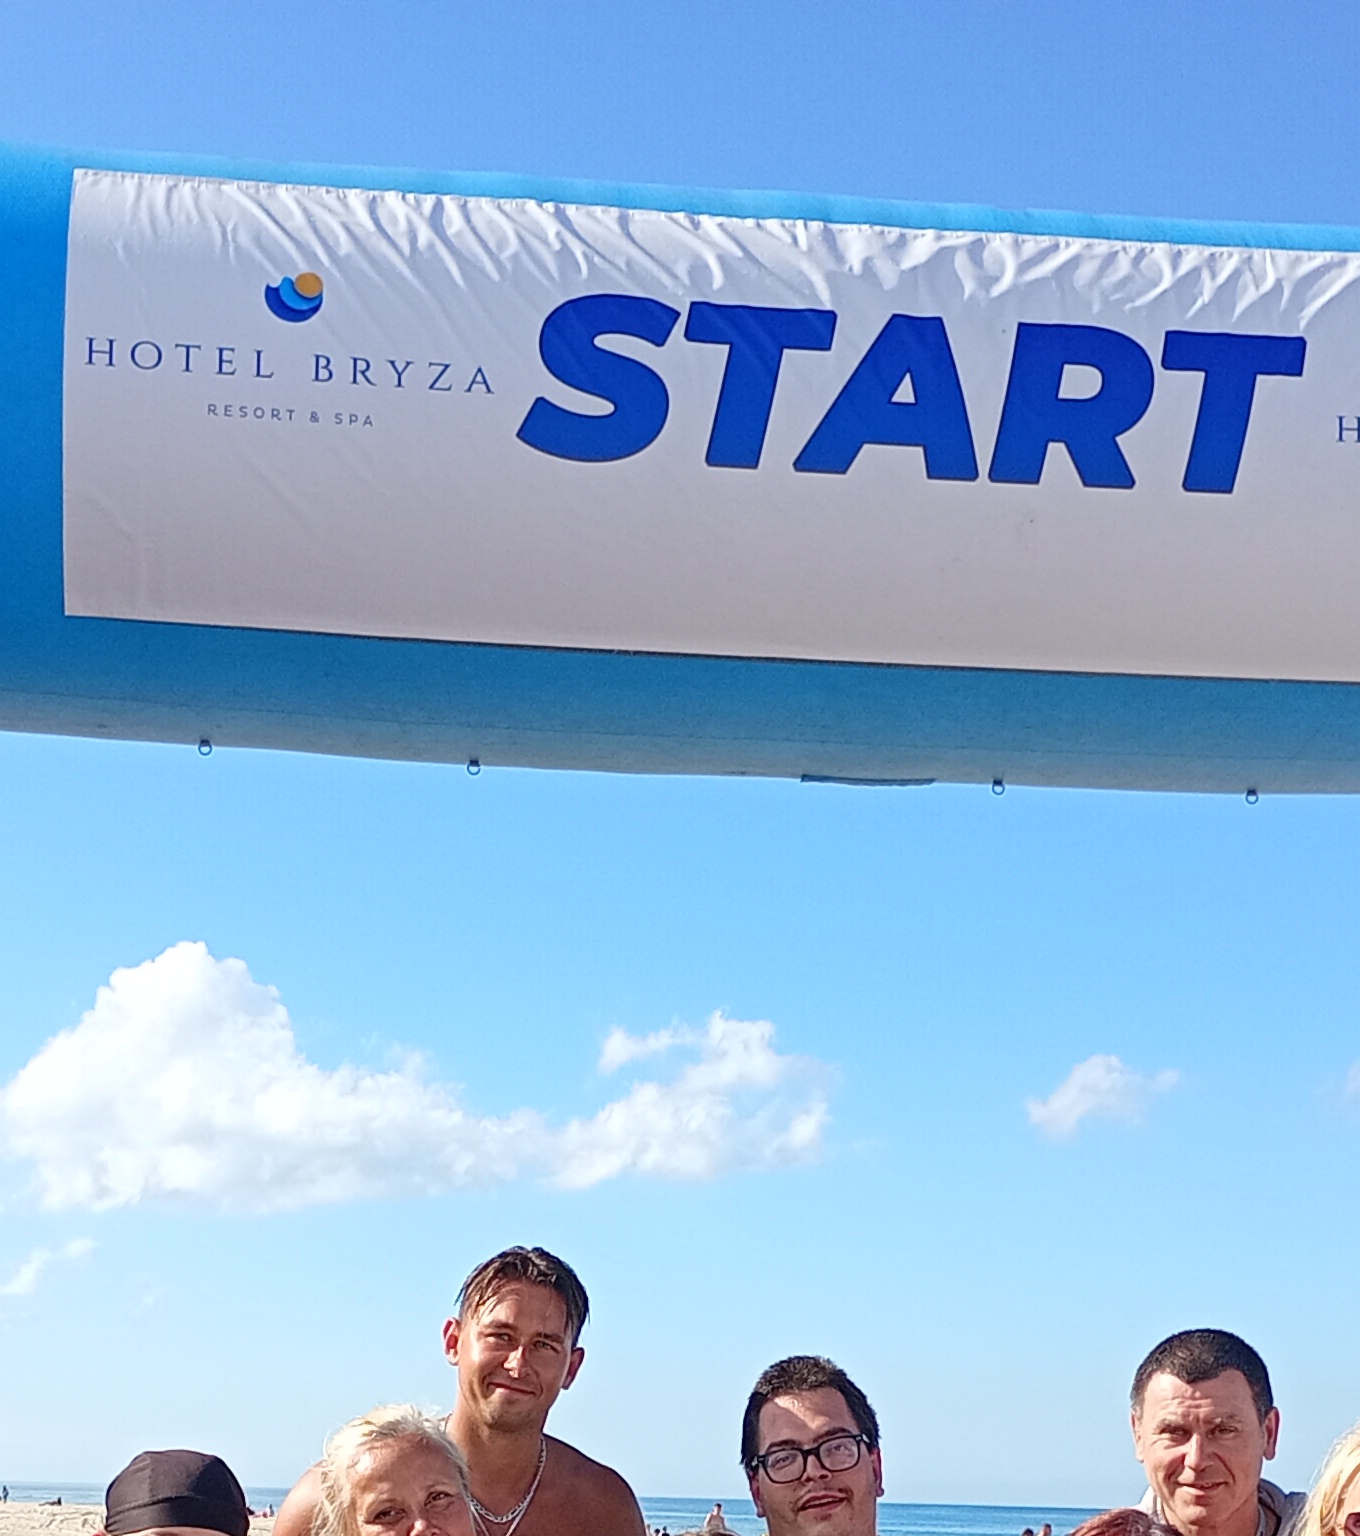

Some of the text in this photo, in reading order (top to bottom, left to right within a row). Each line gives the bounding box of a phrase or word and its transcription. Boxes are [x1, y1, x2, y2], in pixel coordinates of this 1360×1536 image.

[84, 336, 496, 395] HOTEL BRYZA
[516, 293, 1307, 495] START
[207, 402, 375, 428] RESORT & SPA
